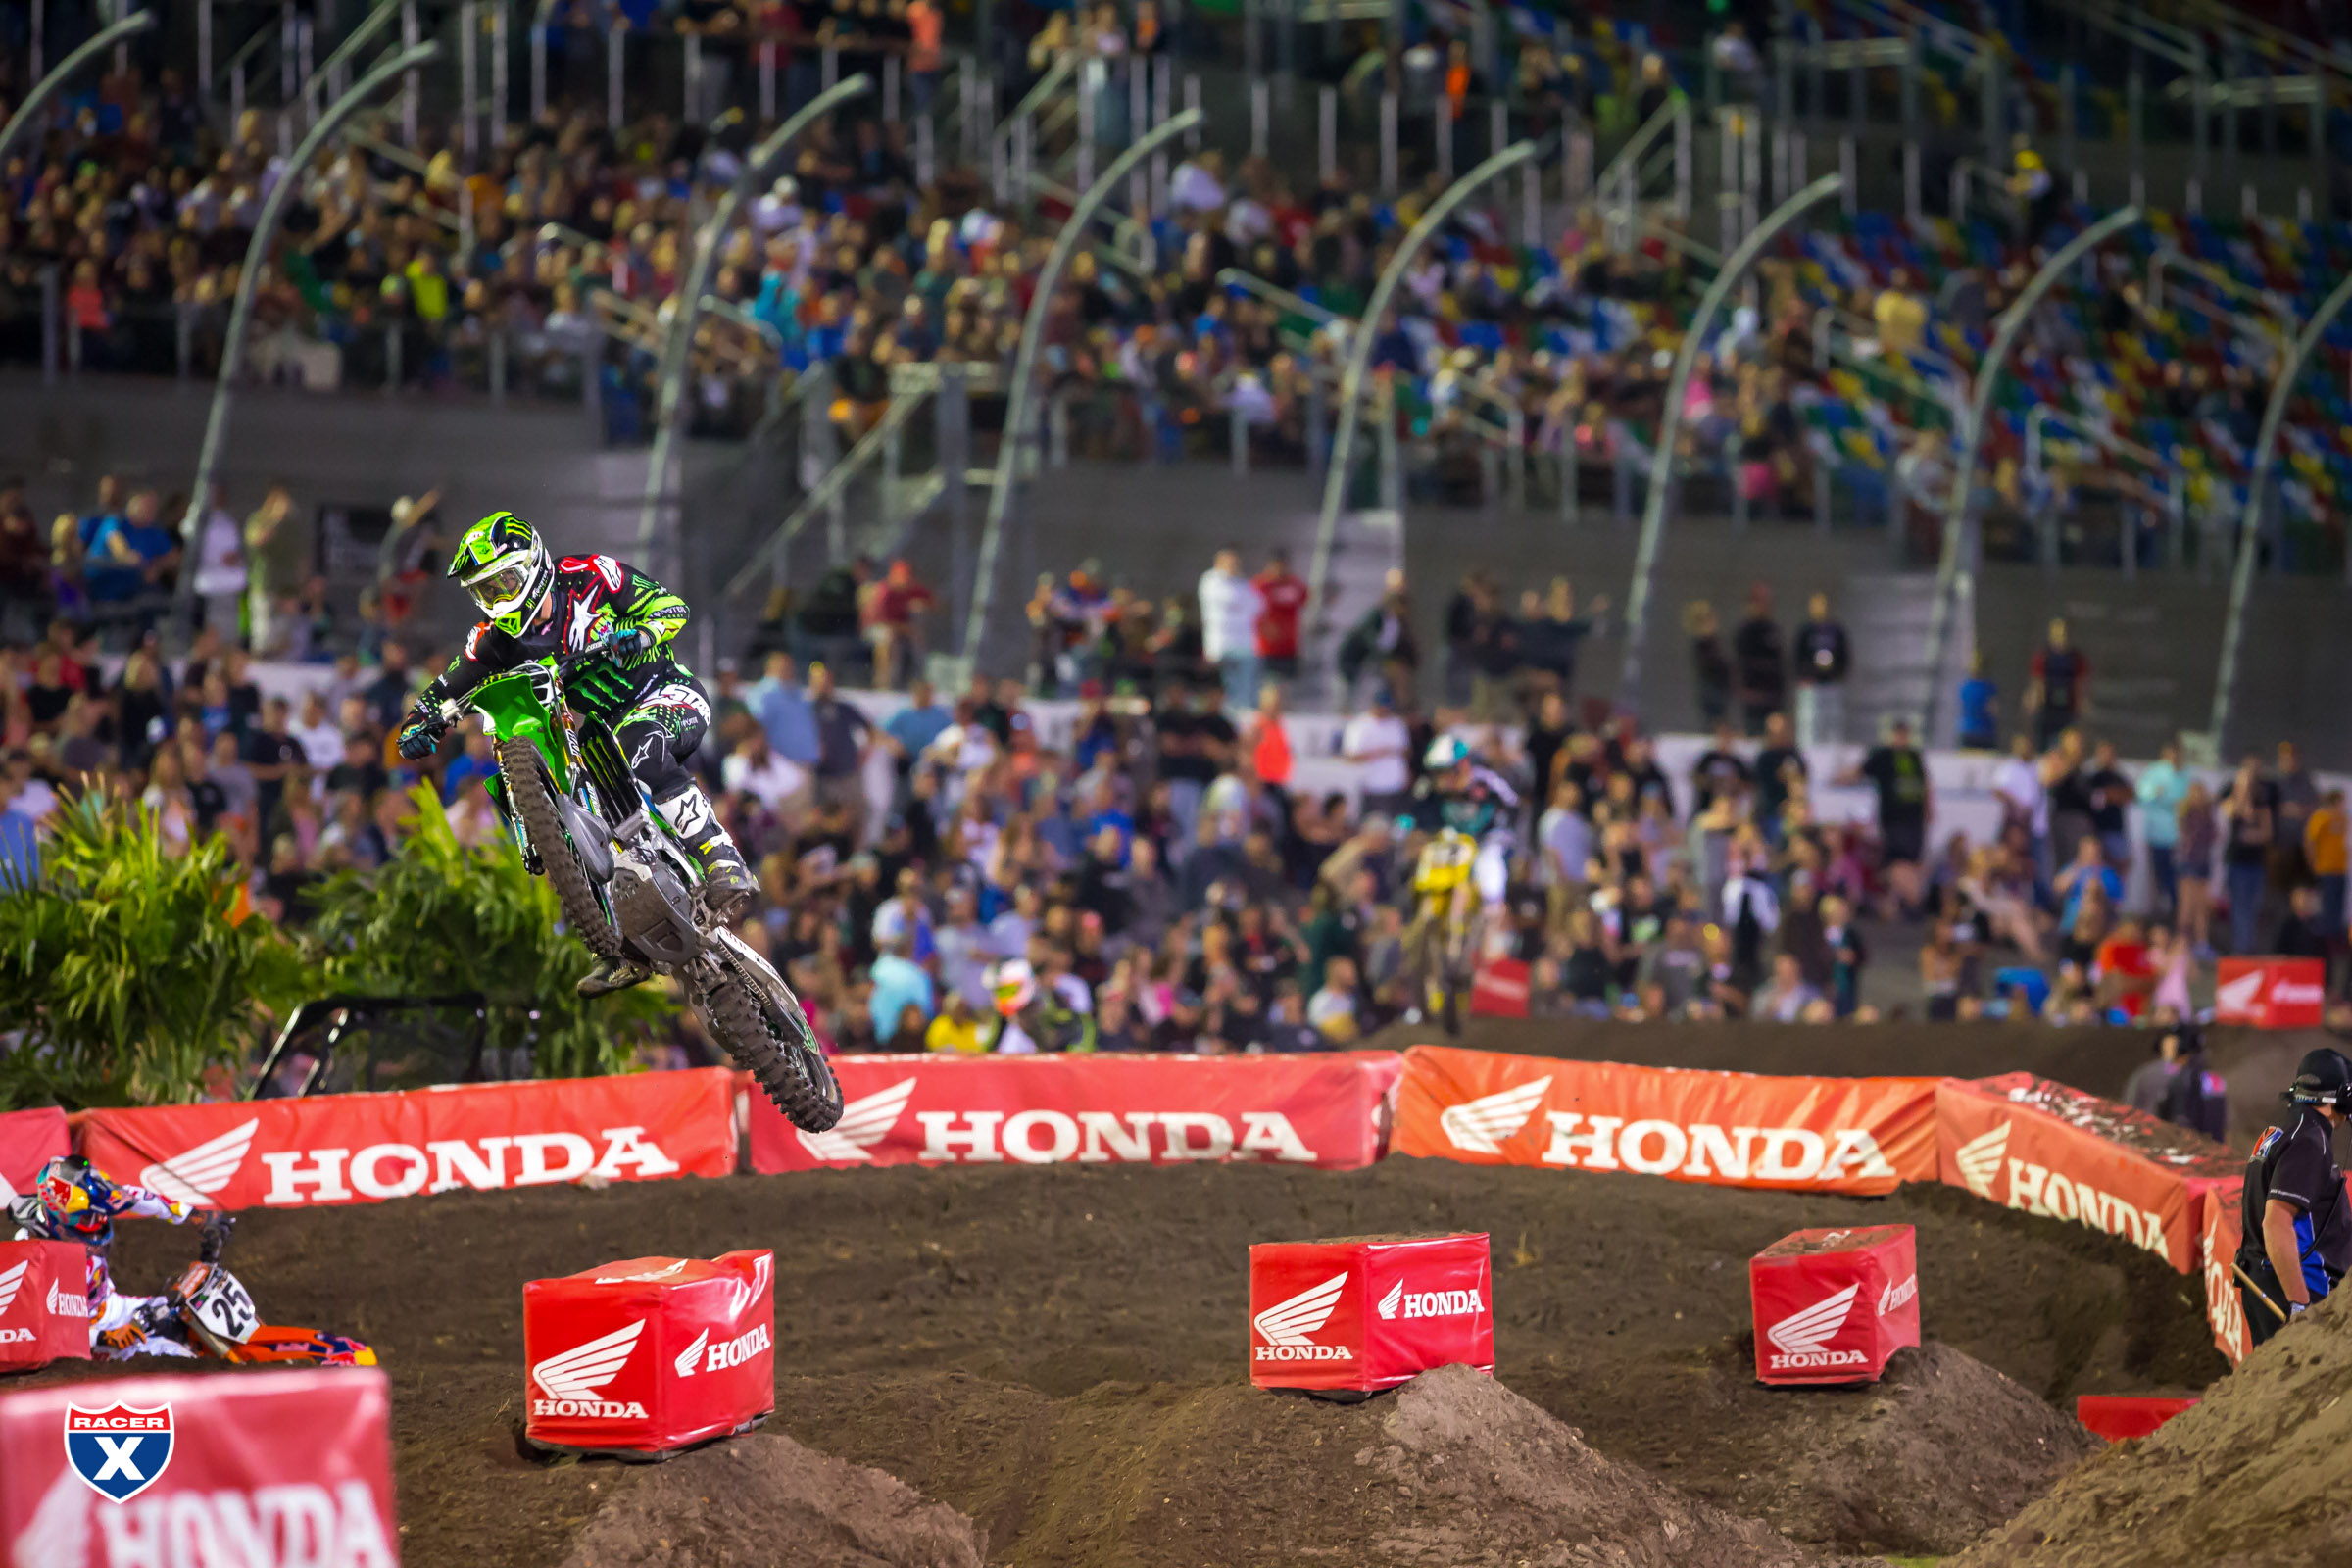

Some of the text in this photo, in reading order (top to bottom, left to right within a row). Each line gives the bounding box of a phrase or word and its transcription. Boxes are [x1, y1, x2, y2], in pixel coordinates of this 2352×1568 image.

[915, 1108, 1317, 1164] HONDA
[1542, 1110, 1896, 1181] HONDA
[262, 1125, 679, 1204] HONDA
[2007, 1156, 2170, 1261] HONDA
[58, 1292, 89, 1317] HONDA
[211, 1281, 255, 1338] 25
[1404, 1288, 1486, 1319] HONDA
[705, 1323, 771, 1373] HONDA
[1254, 1345, 1354, 1361] HONDA
[1769, 1349, 1869, 1370] HONDA
[532, 1398, 650, 1419] HONDA
[100, 1479, 399, 1568] HONDA
